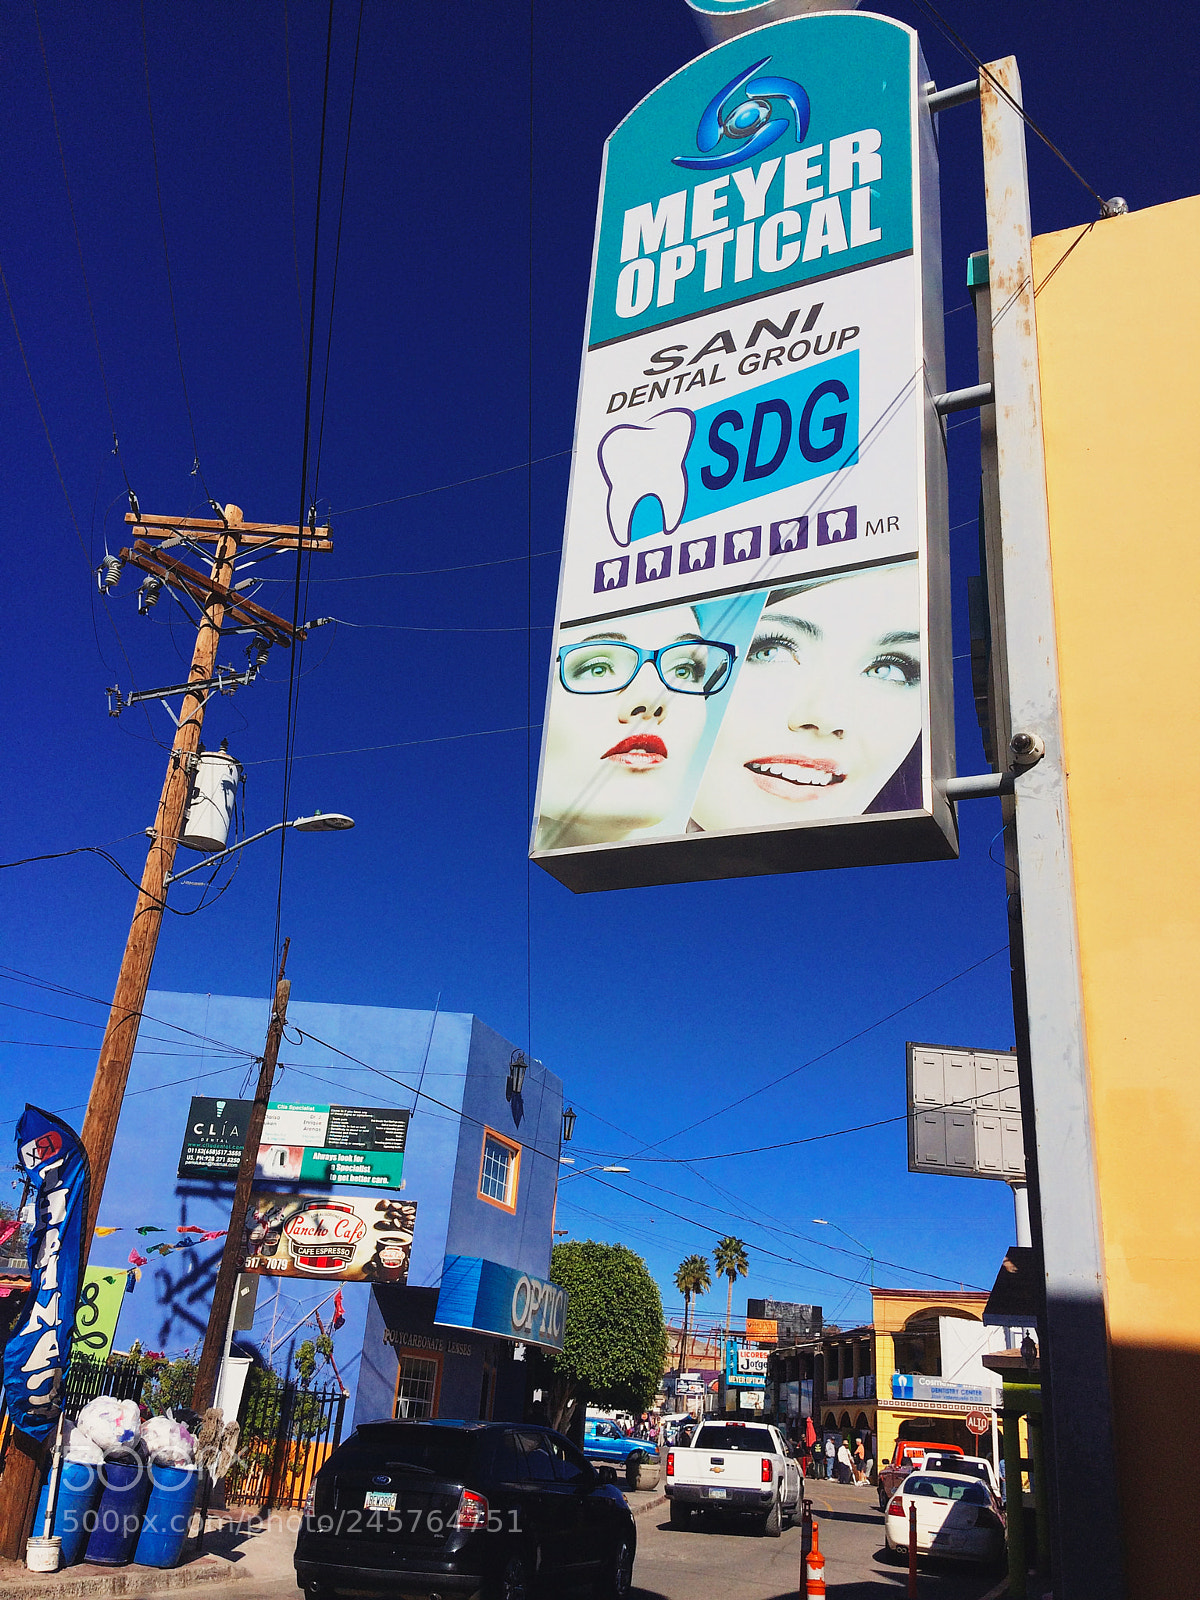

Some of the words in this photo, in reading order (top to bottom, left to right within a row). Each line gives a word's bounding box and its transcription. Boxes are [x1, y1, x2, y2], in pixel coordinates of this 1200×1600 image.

[620, 128, 882, 263] MEYER
[615, 186, 882, 319] OPTICAL
[643, 302, 824, 376] SANI
[606, 364, 726, 414] DENTAL
[738, 326, 860, 376] GROUP
[700, 379, 850, 491] SDG
[865, 516, 900, 537] MR
[313, 1152, 337, 1161] Always
[338, 1154, 352, 1162] look
[336, 1164, 371, 1173] Specialist
[338, 1174, 348, 1182] get
[350, 1174, 371, 1183] better
[285, 1216, 329, 1237] Pancho
[316, 1248, 350, 1256] ESPRESSO
[512, 1276, 566, 1338] OPTIC
[383, 1328, 443, 1352] POLYCARBONATE
[448, 1340, 472, 1356] LENSES
[741, 1359, 767, 1371] Jorge
[968, 1417, 987, 1428] ALTO
